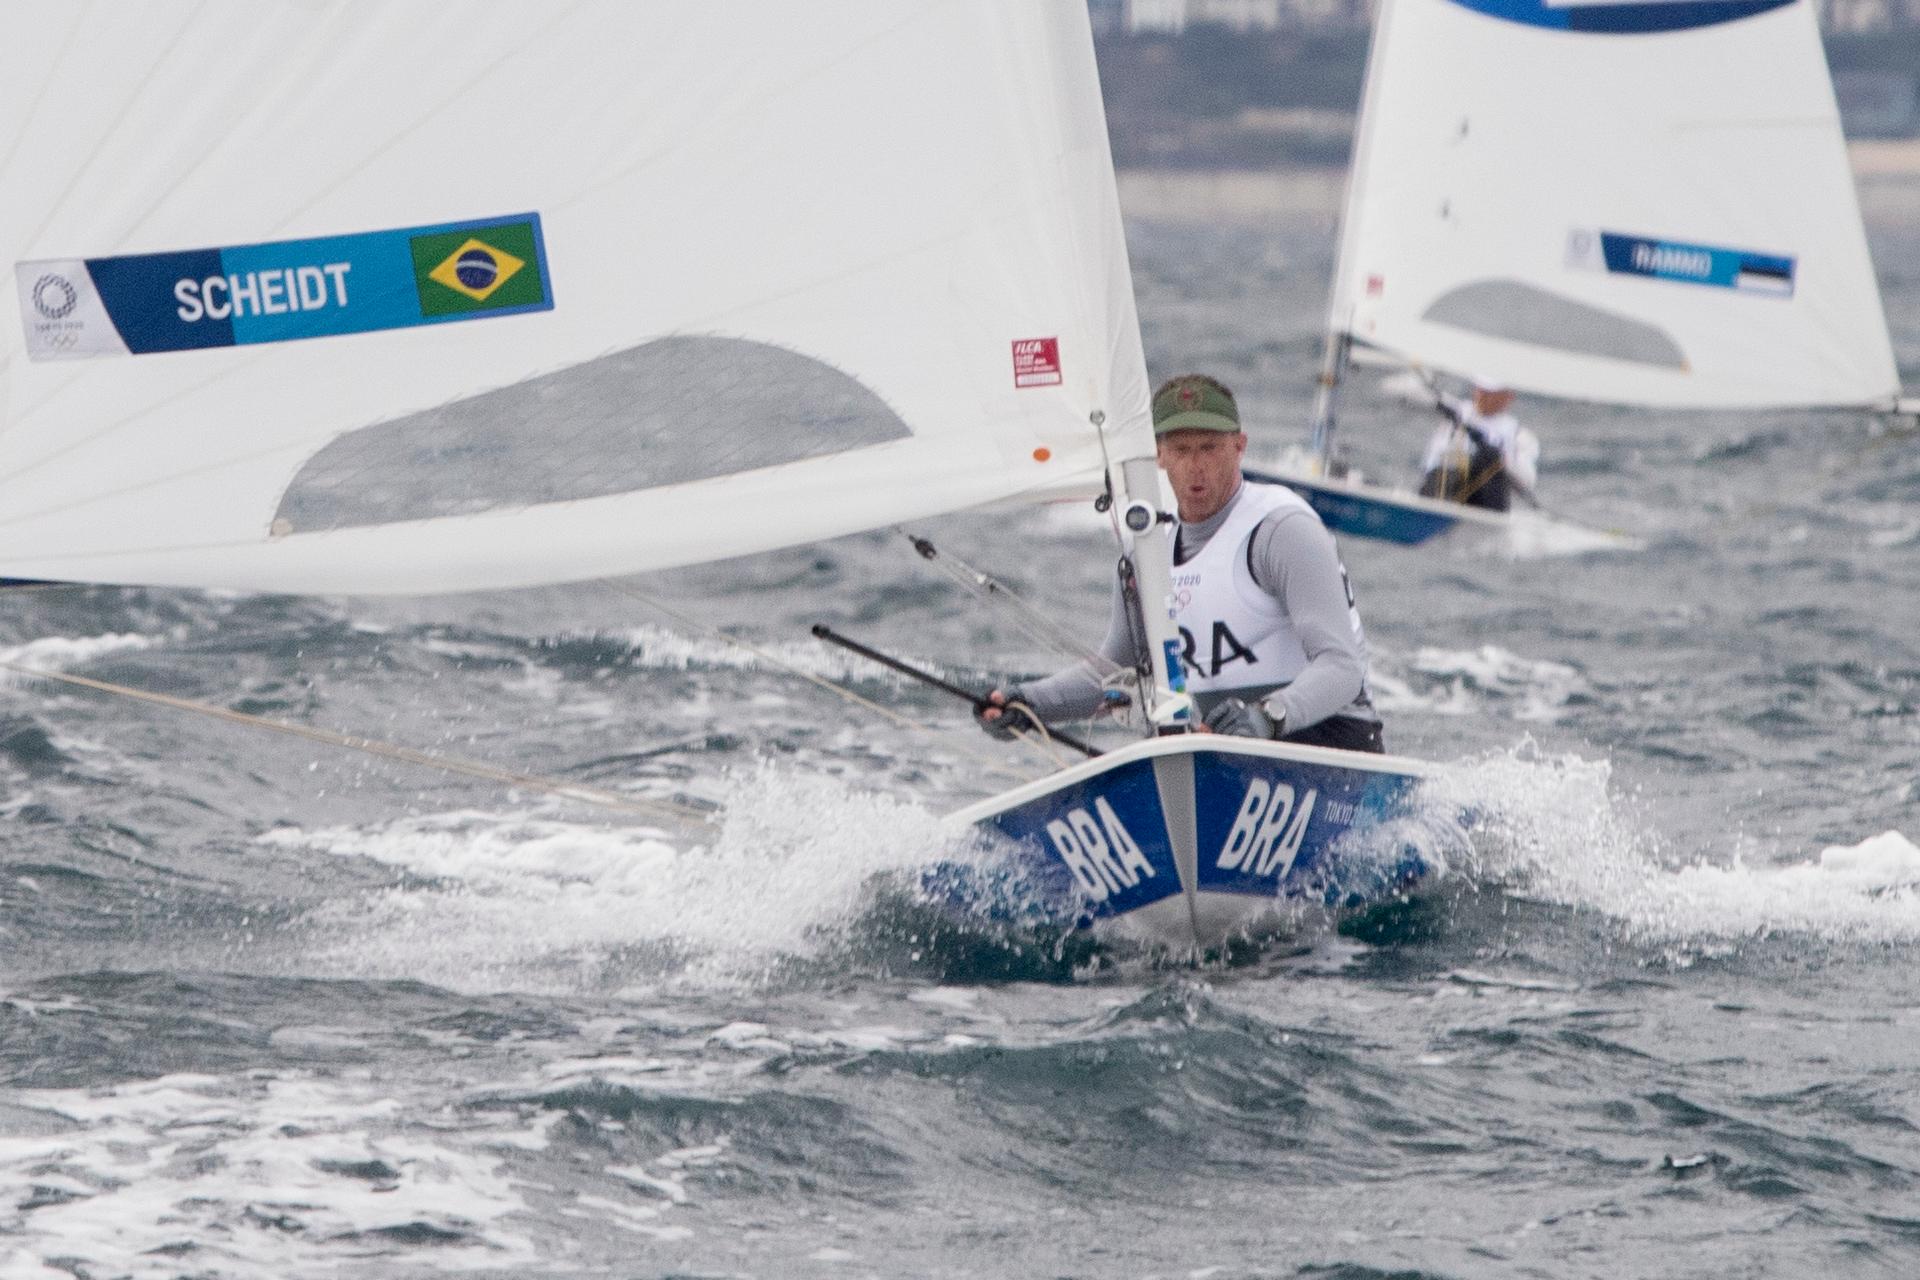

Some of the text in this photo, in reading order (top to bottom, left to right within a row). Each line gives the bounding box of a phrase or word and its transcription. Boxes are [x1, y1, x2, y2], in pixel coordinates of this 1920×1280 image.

[174, 262, 352, 323] SCHEIDT
[1178, 574, 1202, 588] 2020
[1216, 777, 1318, 880] BRA
[1325, 799, 1354, 825] TOKYO
[1046, 795, 1156, 905] BRA
